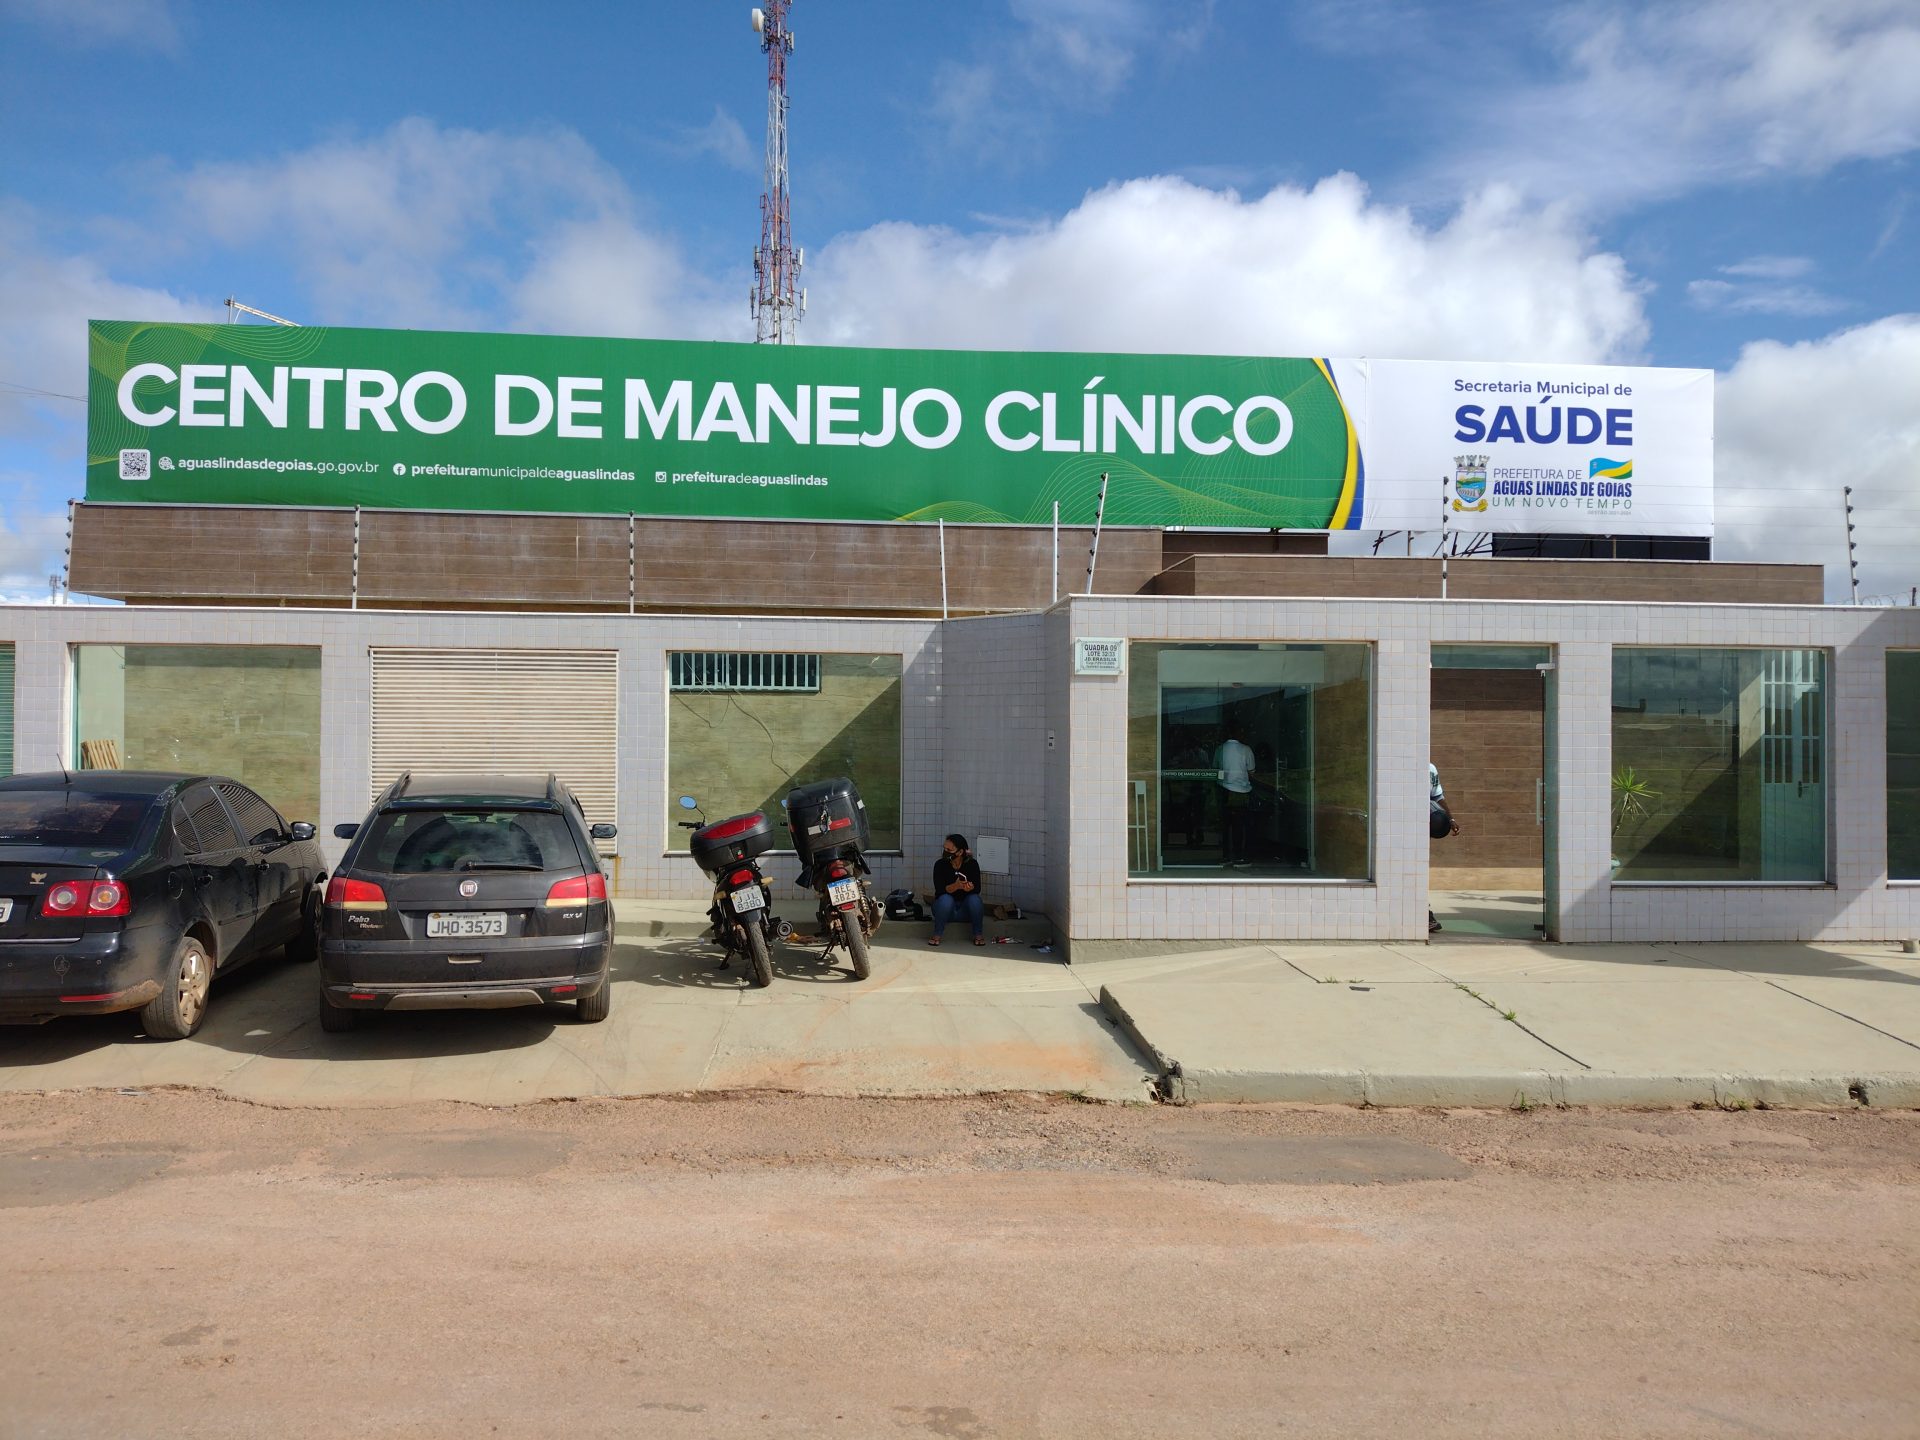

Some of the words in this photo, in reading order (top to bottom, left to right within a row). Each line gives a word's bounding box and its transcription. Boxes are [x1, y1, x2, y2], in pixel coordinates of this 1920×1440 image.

[1454, 379, 1532, 393] Secretaria
[1537, 381, 1609, 397] Municipal
[1614, 383, 1632, 395] de
[118, 363, 466, 434] CENTRO
[495, 375, 602, 438] DE
[625, 379, 961, 449] MANEJO
[985, 377, 1293, 455] CLÍNICO
[1454, 395, 1633, 446] SAÚDE
[178, 457, 379, 475] aguaslindasdegoias.go.gov.br
[411, 463, 635, 482] prefeituramunicipaldeaguaslindas
[1493, 468, 1563, 480] PREFEITURA
[1567, 469, 1582, 480] DE
[672, 471, 828, 487] prefeituradeaguaslindas
[1536, 480, 1577, 497] LINDAS
[1580, 481, 1595, 497] DE
[1597, 482, 1632, 498] GOIÁS
[1492, 497, 1515, 507] UM
[1522, 497, 1569, 508] NOVO
[1576, 498, 1632, 509] TEMPO
[834, 884, 852, 894] REE
